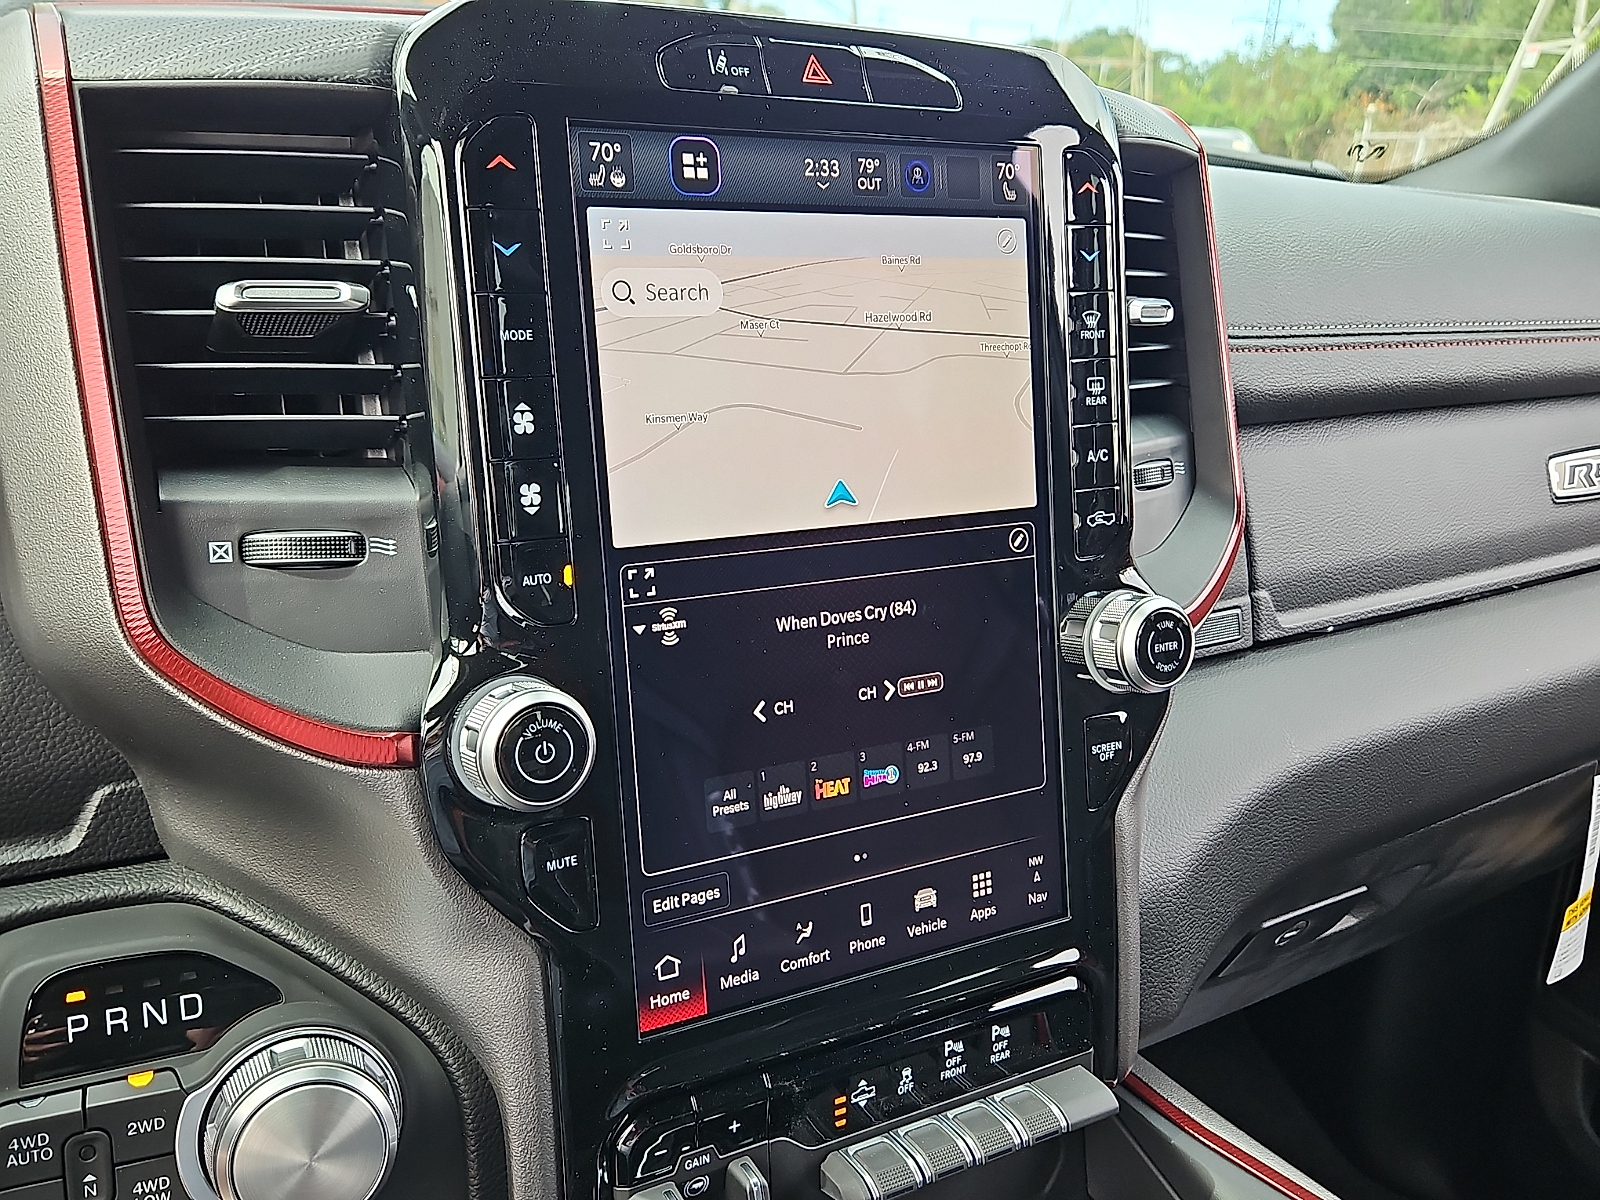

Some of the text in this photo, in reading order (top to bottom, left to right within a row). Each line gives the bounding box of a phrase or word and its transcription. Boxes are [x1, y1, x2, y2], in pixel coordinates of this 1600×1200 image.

[731, 66, 750, 77] OFF
[589, 141, 621, 163] 70°
[805, 159, 839, 178] 2:33
[857, 158, 880, 174] 79°
[996, 163, 1021, 180] 70°
[857, 176, 881, 192] OUT
[669, 244, 732, 256] Goldsboro Dr
[882, 255, 921, 266] Baines Rd
[646, 283, 709, 301] Search
[740, 319, 780, 330] Maser Ct
[865, 311, 932, 323] Hazelwood Rd
[500, 330, 533, 341] MODE
[1081, 330, 1105, 339] FRONT
[981, 343, 1022, 352] Threechopt
[1086, 397, 1107, 405] REAR
[645, 412, 708, 424] Kinsmen Way
[1087, 450, 1108, 462] A/C
[522, 573, 552, 586] AUTO
[776, 599, 917, 633] When Doves Cry (84)
[1157, 619, 1175, 631] TUNE
[827, 631, 870, 649] Prince
[1154, 642, 1179, 654] ENTER
[1155, 660, 1180, 673] SCROLL
[858, 685, 878, 701] CH
[774, 700, 794, 716] CH
[523, 719, 563, 739] VOLUME
[952, 730, 975, 744] 5-FM
[906, 739, 930, 752] 4-FM
[1091, 741, 1123, 755] SCREEN
[859, 752, 867, 762] 3
[962, 750, 983, 765] 97.9
[1100, 752, 1115, 762] OFF
[810, 761, 818, 772] 2
[917, 760, 938, 773] 92.3
[760, 771, 766, 782] 1
[724, 789, 738, 801] All
[814, 777, 851, 800] HEAT
[763, 790, 803, 808] highway
[712, 800, 750, 817] Presets
[546, 854, 578, 873] MUTE
[1028, 854, 1044, 867] NW
[652, 886, 721, 914] Edit Pages
[1027, 891, 1049, 906] Nav
[970, 905, 998, 922] Apps
[906, 916, 948, 938] Vehicle
[848, 933, 886, 954] Phone
[780, 949, 831, 973] Comfort
[719, 968, 760, 991] Media
[649, 987, 691, 1010] Home
[66, 993, 203, 1043] P R N D
[992, 1040, 1008, 1052] OFF
[945, 1055, 962, 1068] OFF
[990, 1050, 1011, 1064] REAR
[940, 1064, 967, 1081] FRONT
[897, 1082, 914, 1095] OFF
[127, 1117, 165, 1136] 2WD
[8, 1132, 50, 1151] 4WD
[6, 1147, 54, 1168] AUTO
[684, 1153, 711, 1170] GAIN
[84, 1182, 97, 1198] N
[132, 1176, 171, 1196] 4WD
